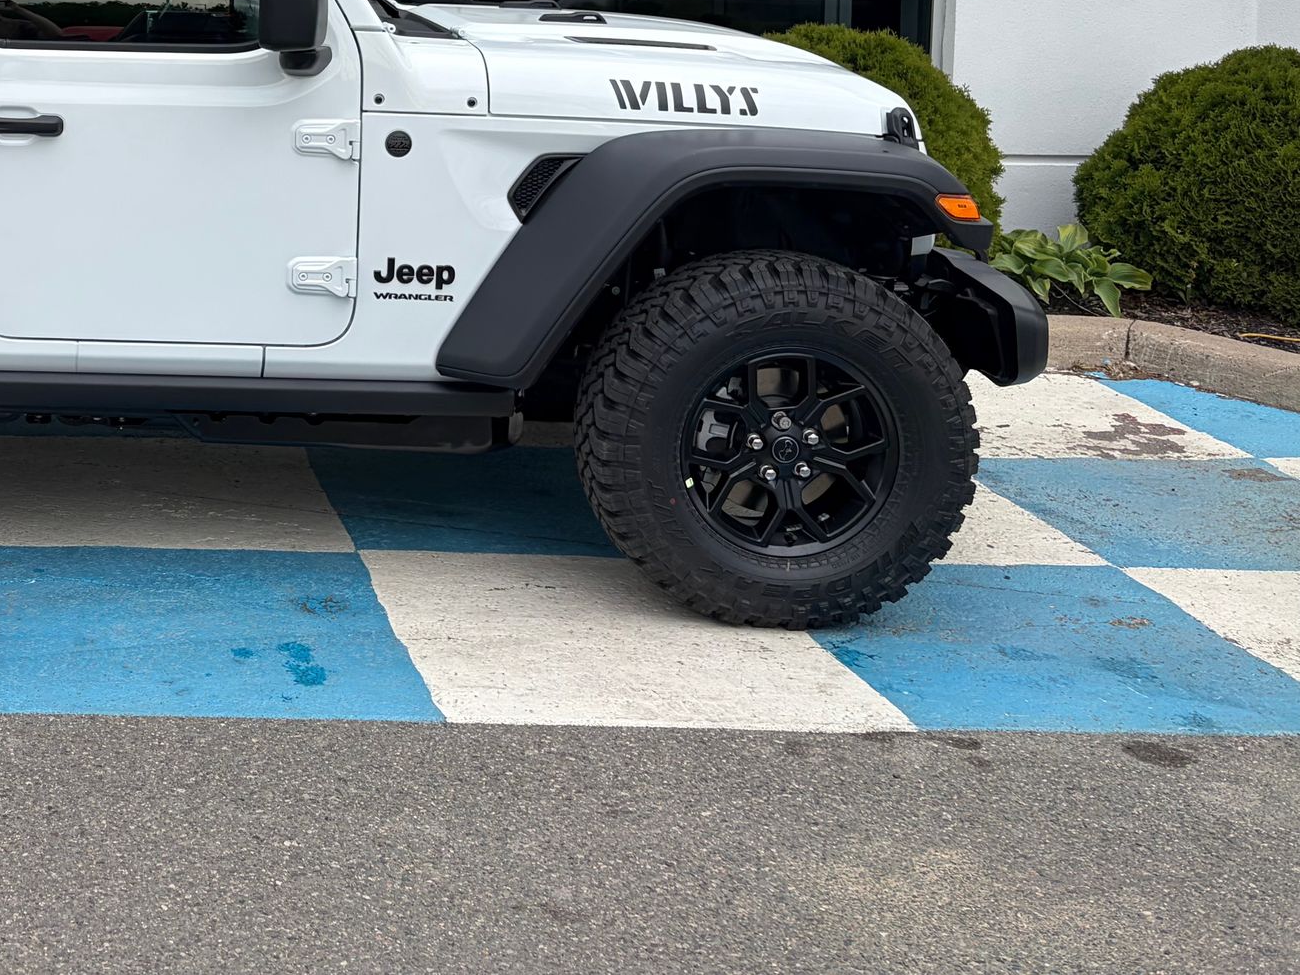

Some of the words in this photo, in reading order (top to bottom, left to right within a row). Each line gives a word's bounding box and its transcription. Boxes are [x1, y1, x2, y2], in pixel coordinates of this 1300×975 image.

[609, 79, 759, 116] WILLYS
[373, 257, 456, 290] Jeep
[373, 292, 454, 302] WRANGLER
